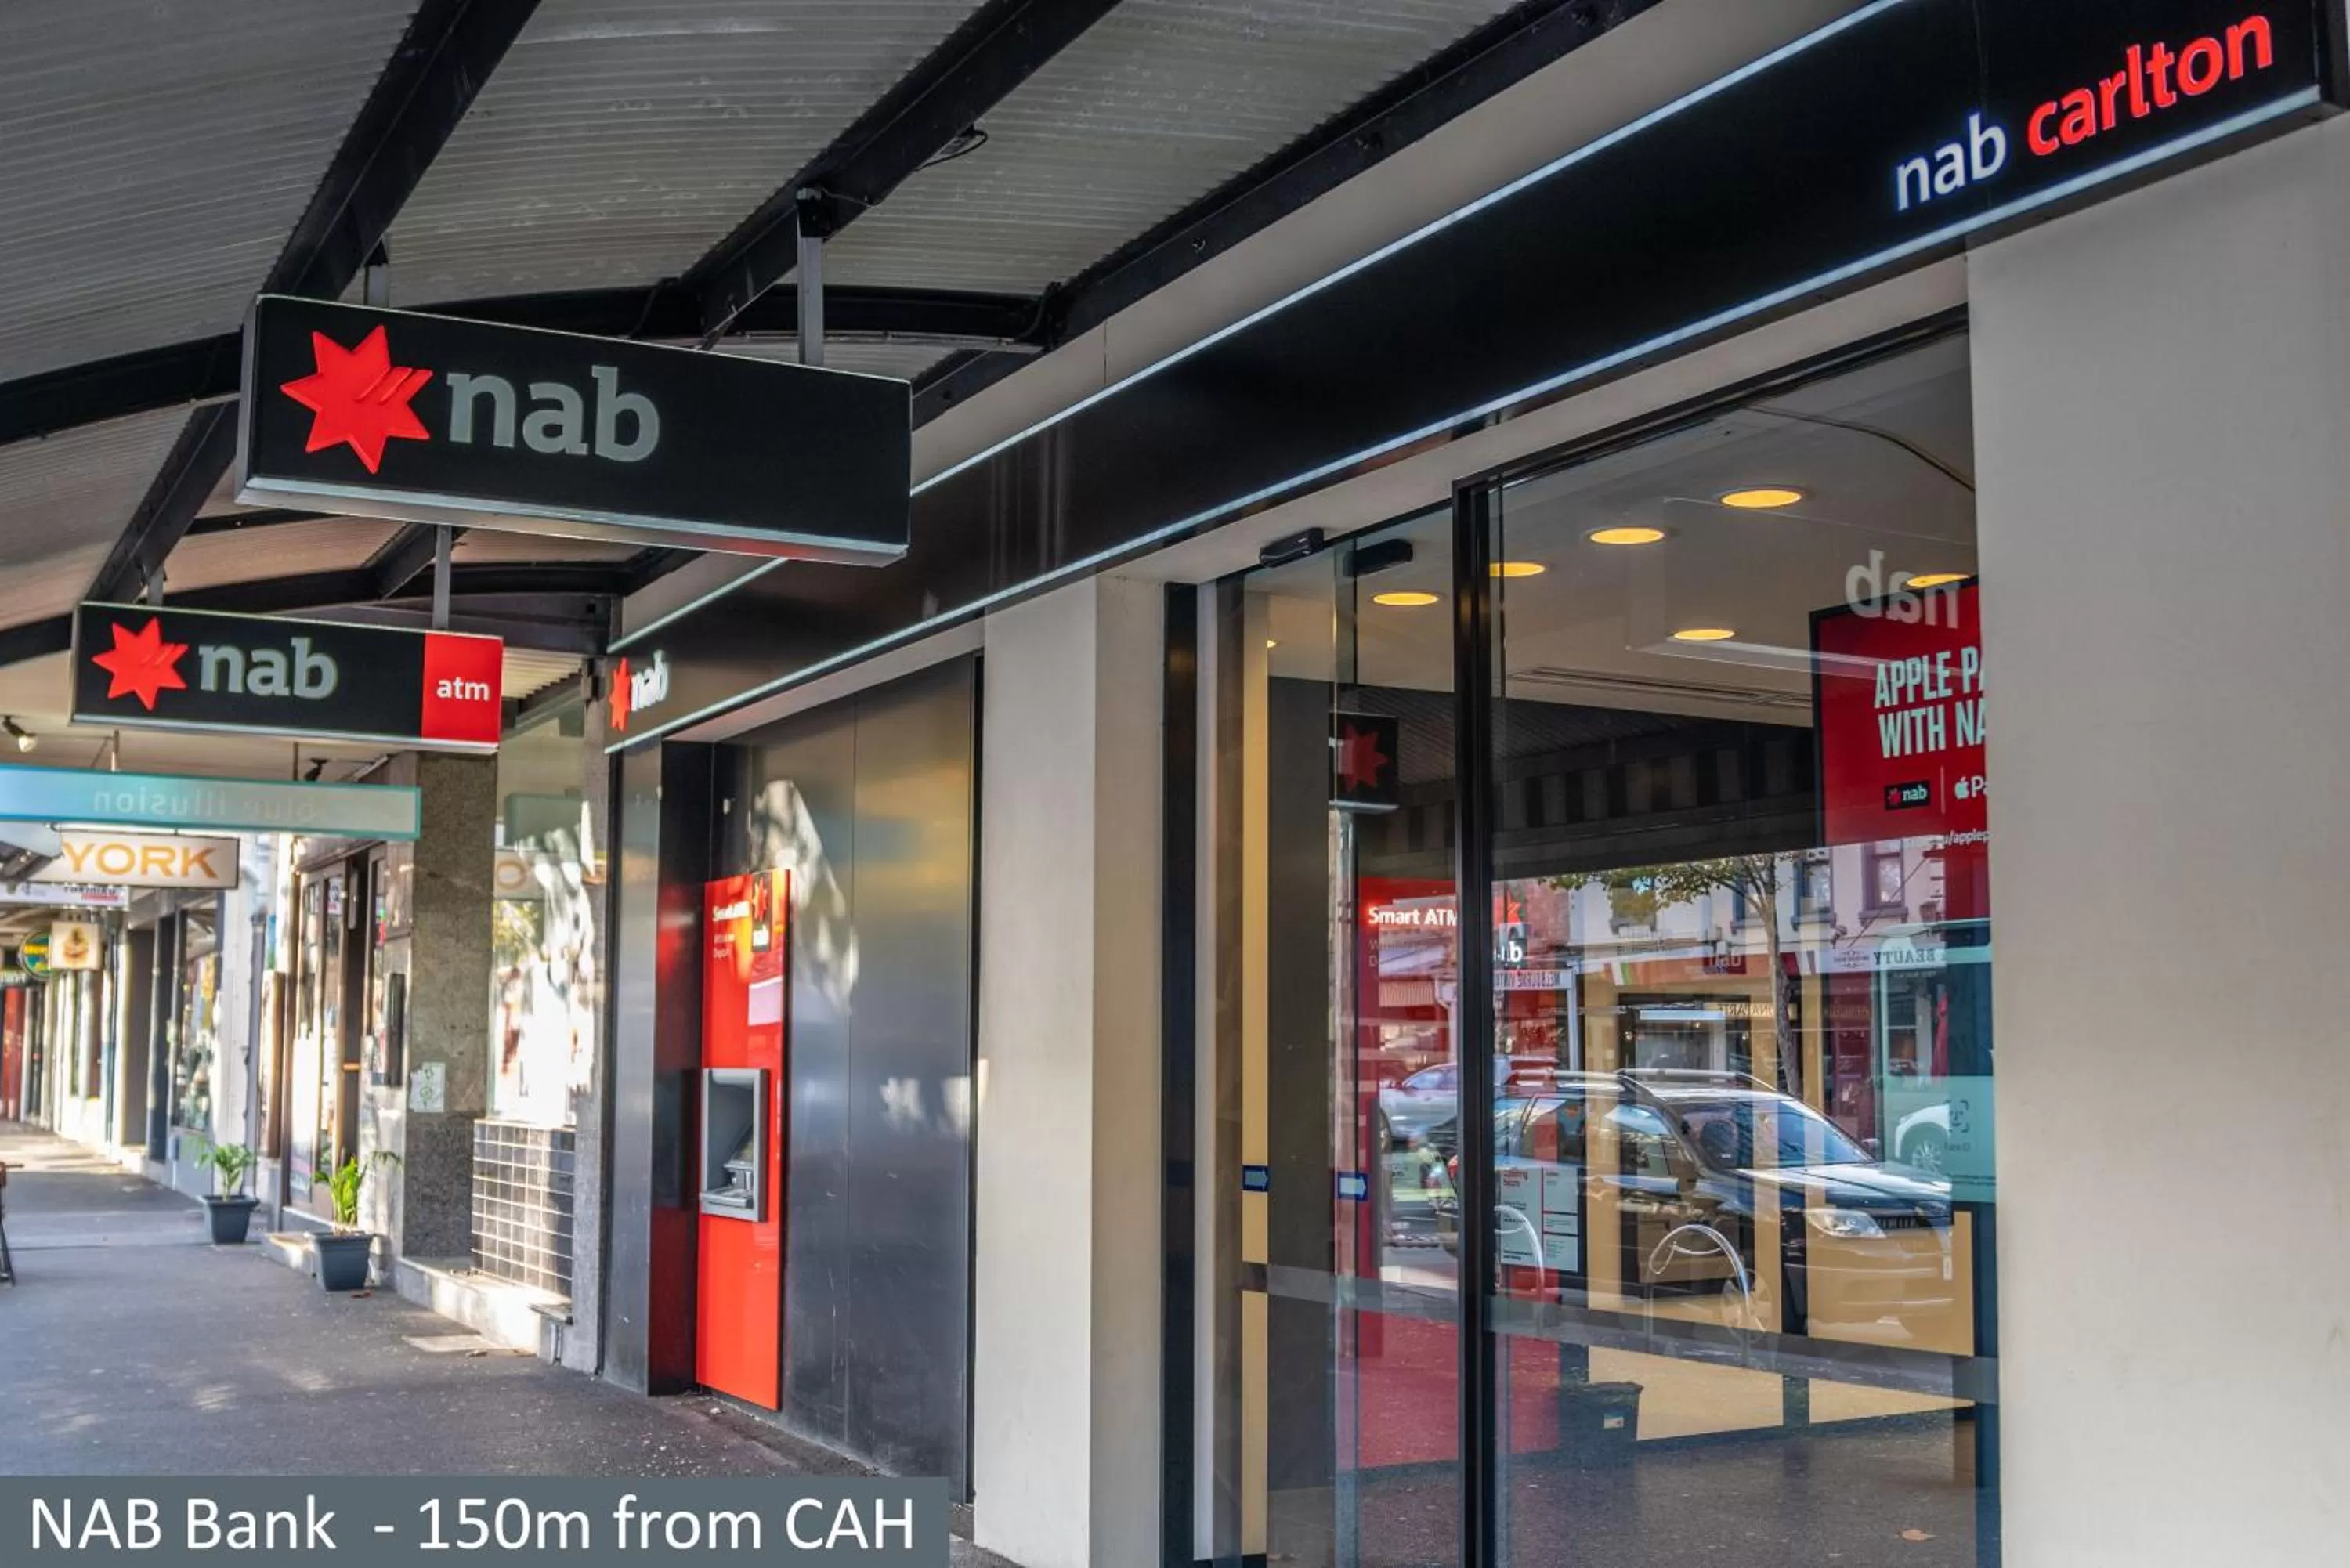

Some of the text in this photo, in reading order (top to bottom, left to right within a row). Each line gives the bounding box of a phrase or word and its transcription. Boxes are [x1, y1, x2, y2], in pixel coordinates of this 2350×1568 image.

[1896, 14, 2273, 212] nab carlton
[446, 365, 660, 462] nab
[198, 636, 338, 699] nab
[436, 677, 490, 702] atm
[631, 649, 669, 712] nab
[1874, 646, 1984, 709] APPLE P
[1878, 703, 1947, 758] WITH
[1902, 784, 1929, 802] nab
[62, 841, 220, 879] YORK
[1368, 906, 1421, 926] Smart
